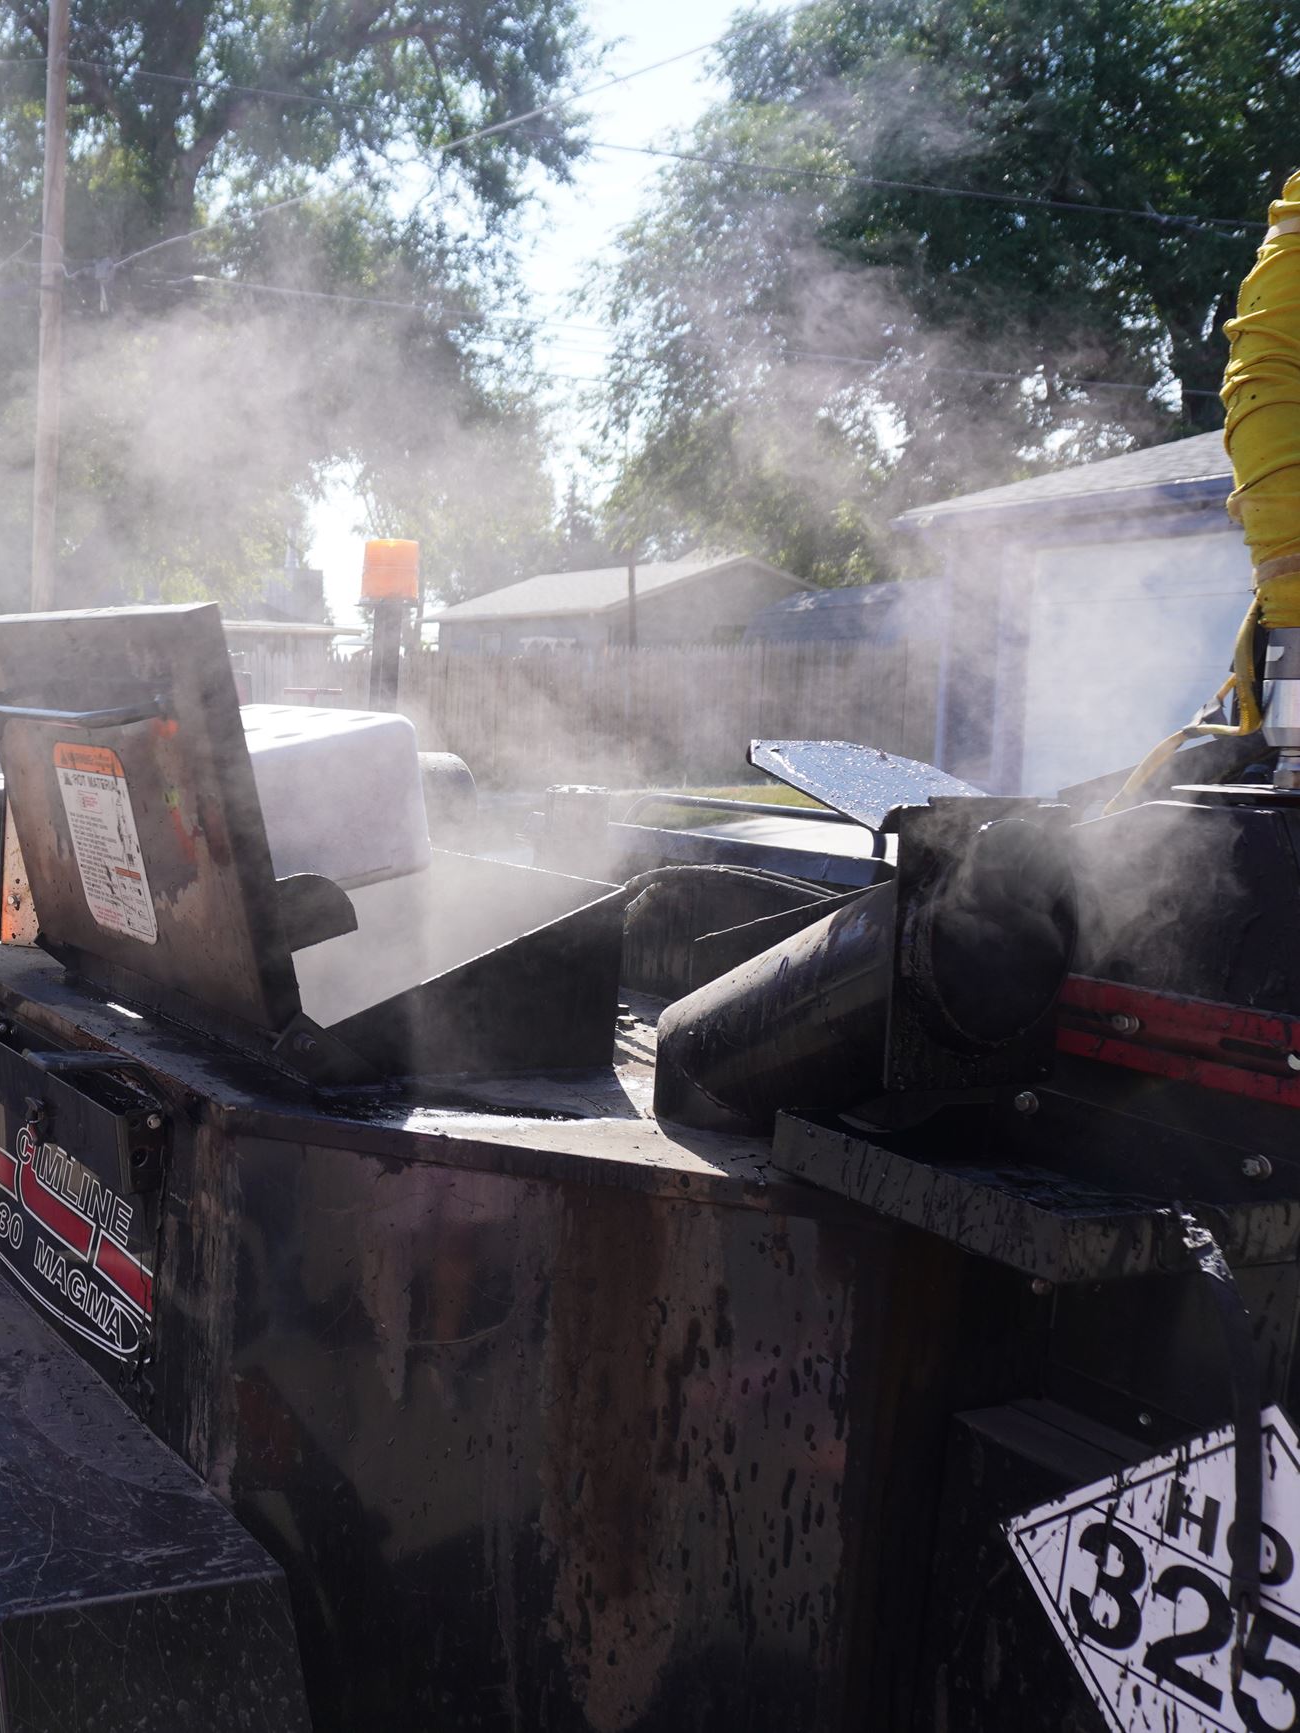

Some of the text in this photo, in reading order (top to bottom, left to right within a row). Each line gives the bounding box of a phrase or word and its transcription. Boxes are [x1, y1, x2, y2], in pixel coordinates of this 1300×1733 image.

[16, 1127, 133, 1246] CIMLINE
[33, 1236, 122, 1349] MAGMA
[1069, 1521, 1300, 1733] 325
